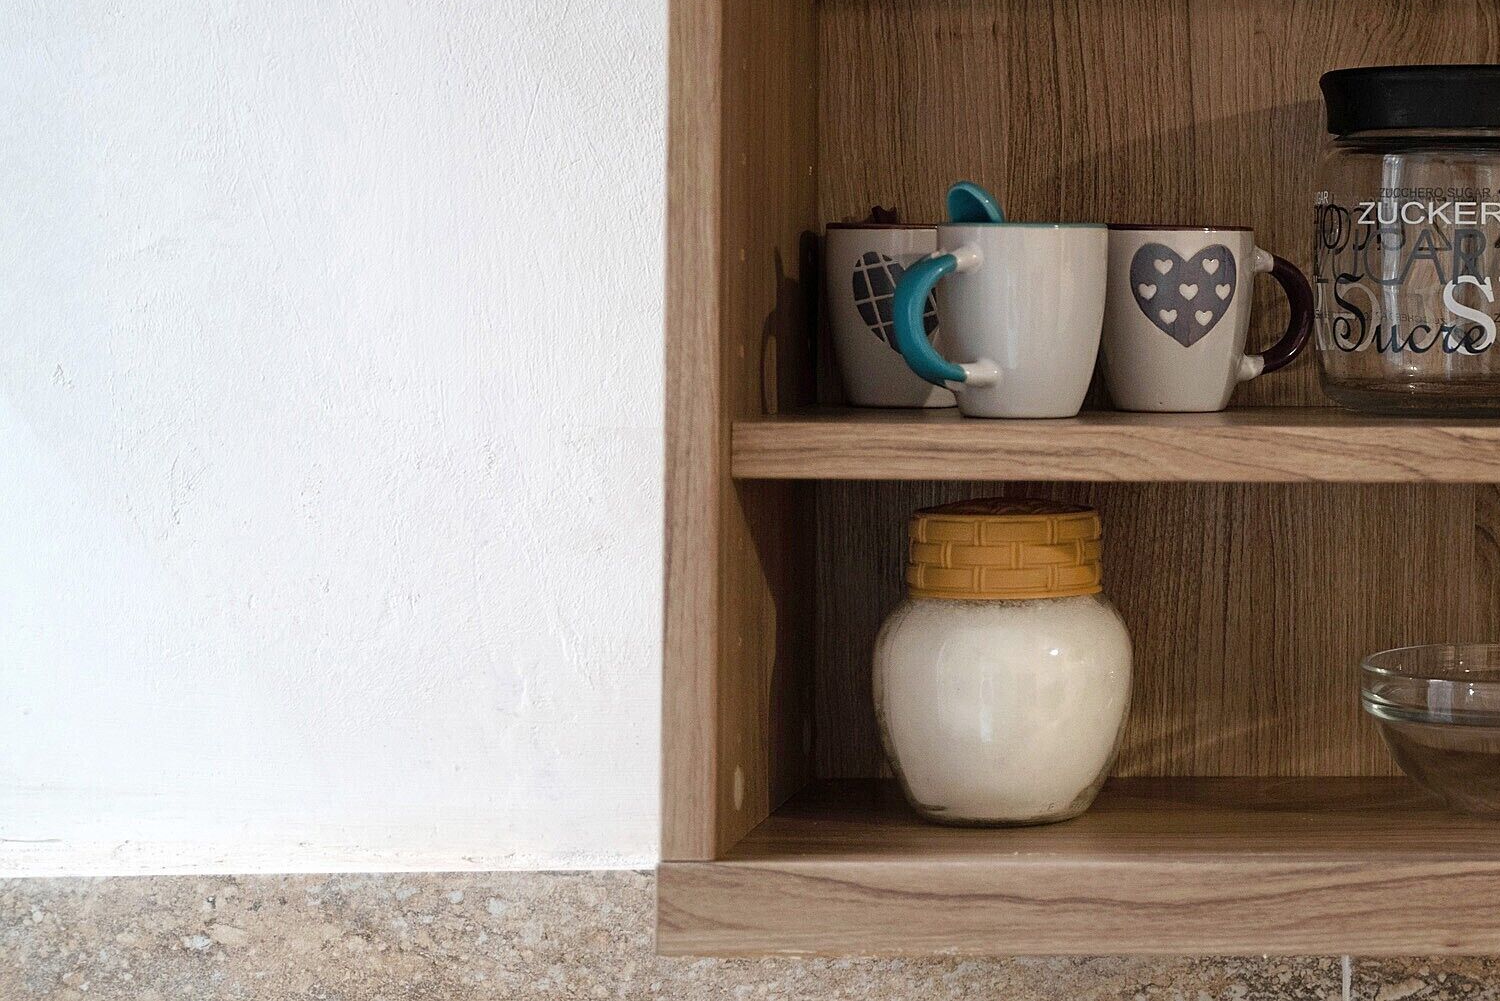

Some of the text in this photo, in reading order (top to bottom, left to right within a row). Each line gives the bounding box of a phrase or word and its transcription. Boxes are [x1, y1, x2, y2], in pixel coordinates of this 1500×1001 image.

[1380, 187, 1490, 198] ZUCCHERO SUGAR
[1332, 272, 1493, 354] Sucre
